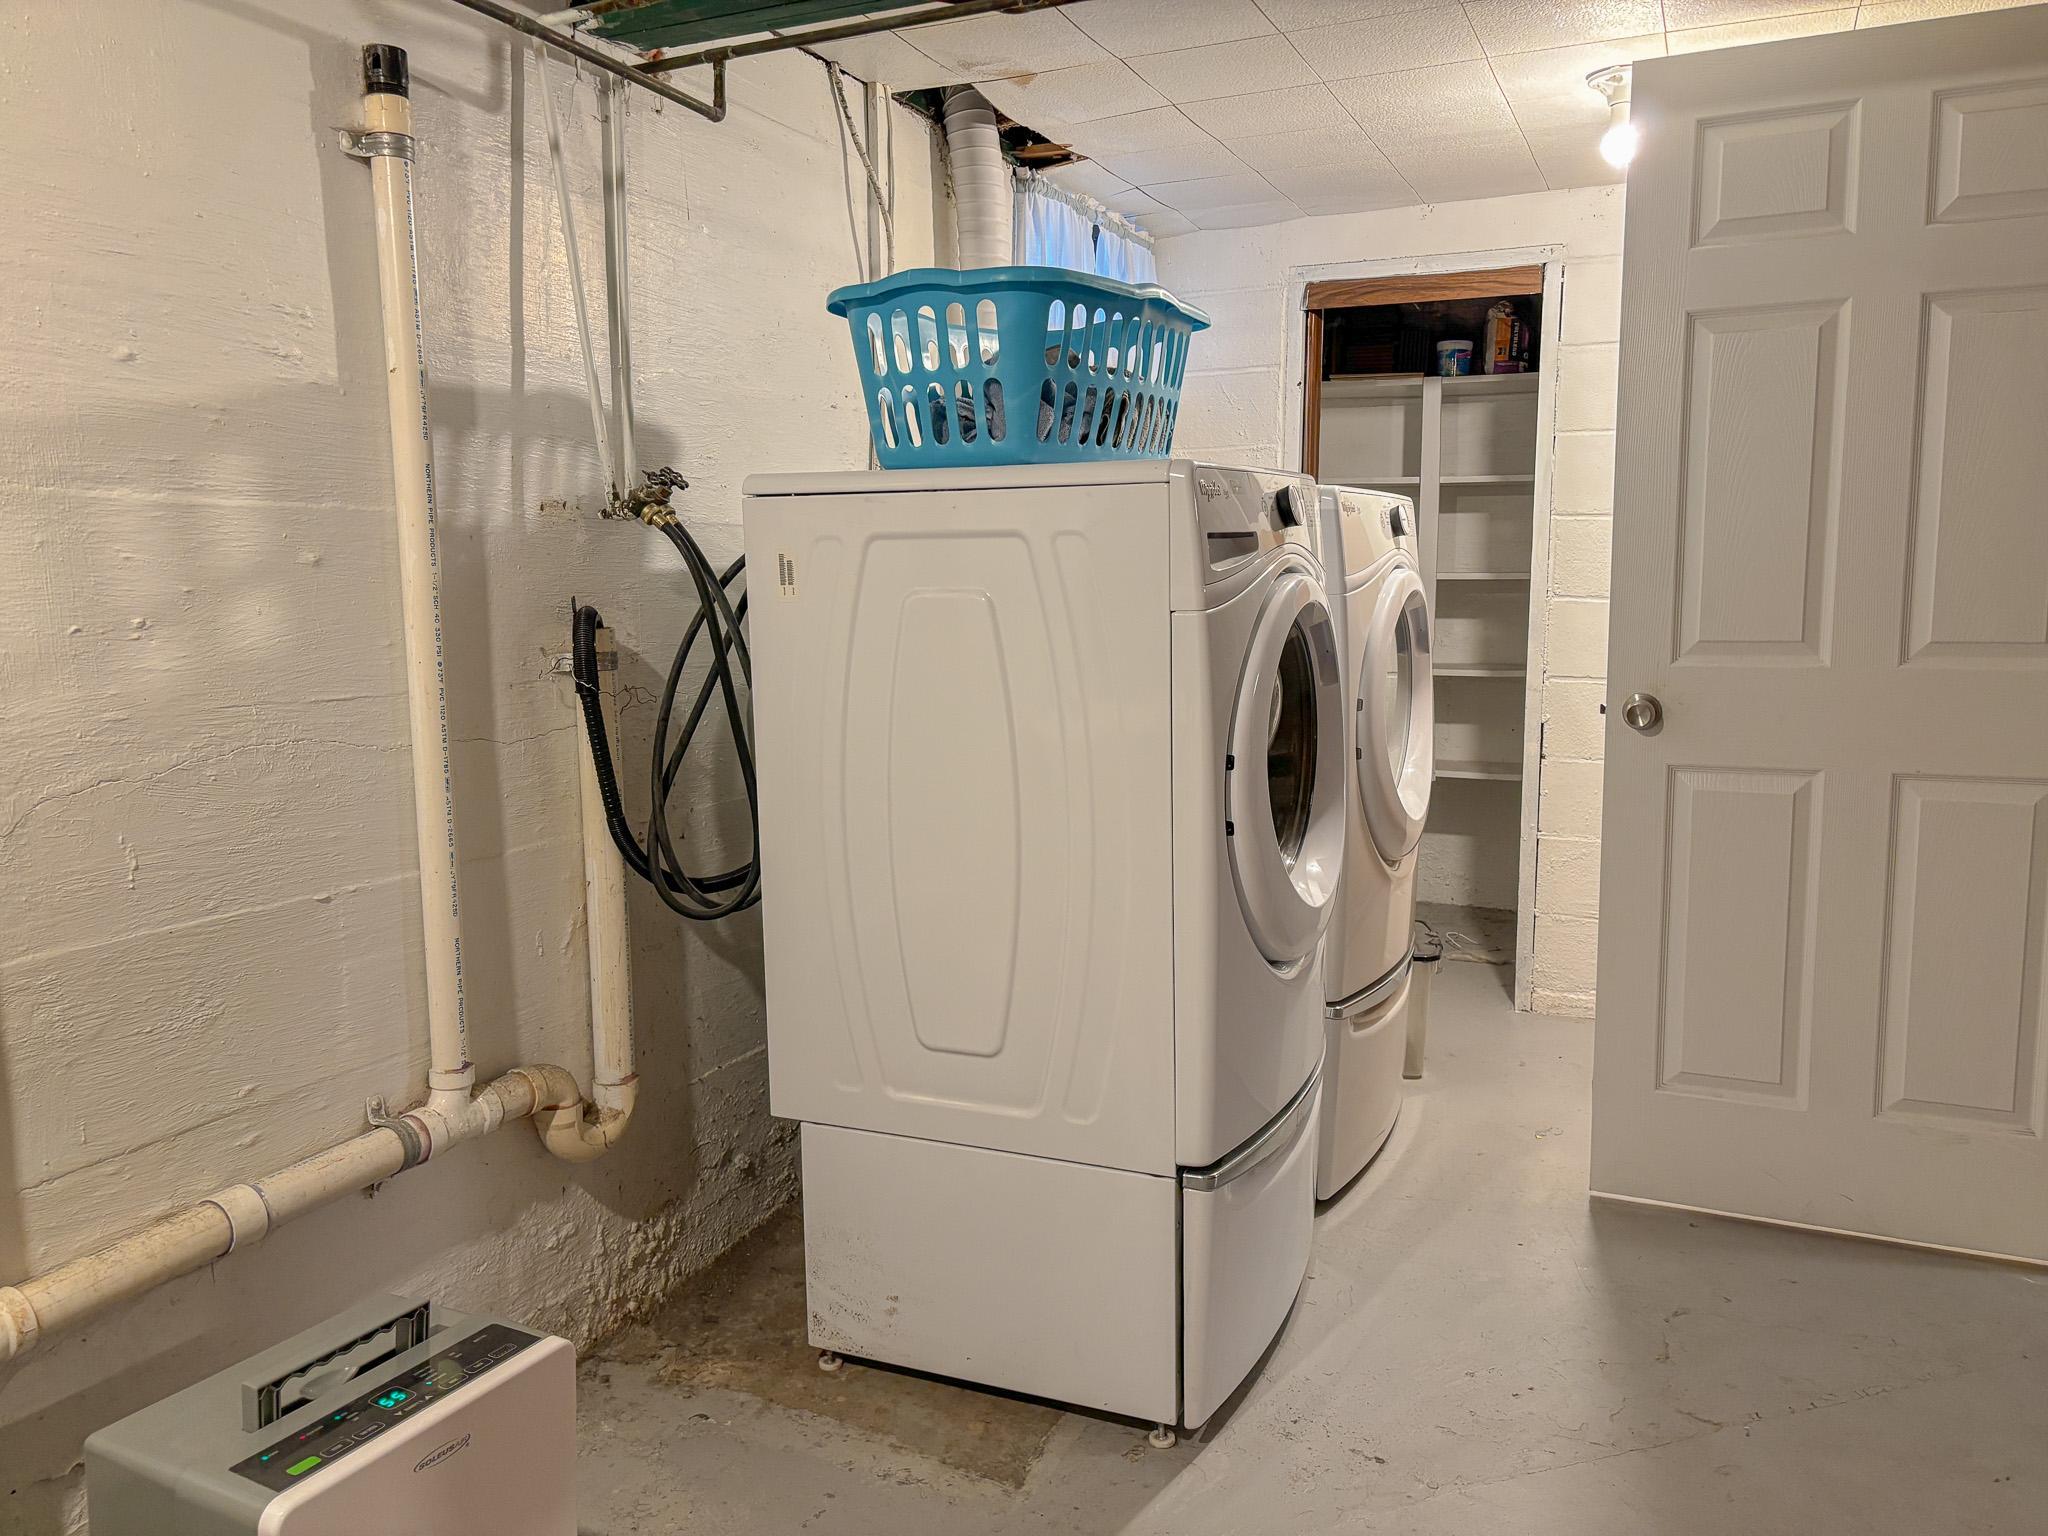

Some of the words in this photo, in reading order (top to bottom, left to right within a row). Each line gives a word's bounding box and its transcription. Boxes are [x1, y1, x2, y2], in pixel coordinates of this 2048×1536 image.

[425, 463, 433, 504] NORTHERN
[429, 527, 437, 567] PRODUCTS
[434, 613, 440, 624] 40
[379, 1391, 407, 1408] 55
